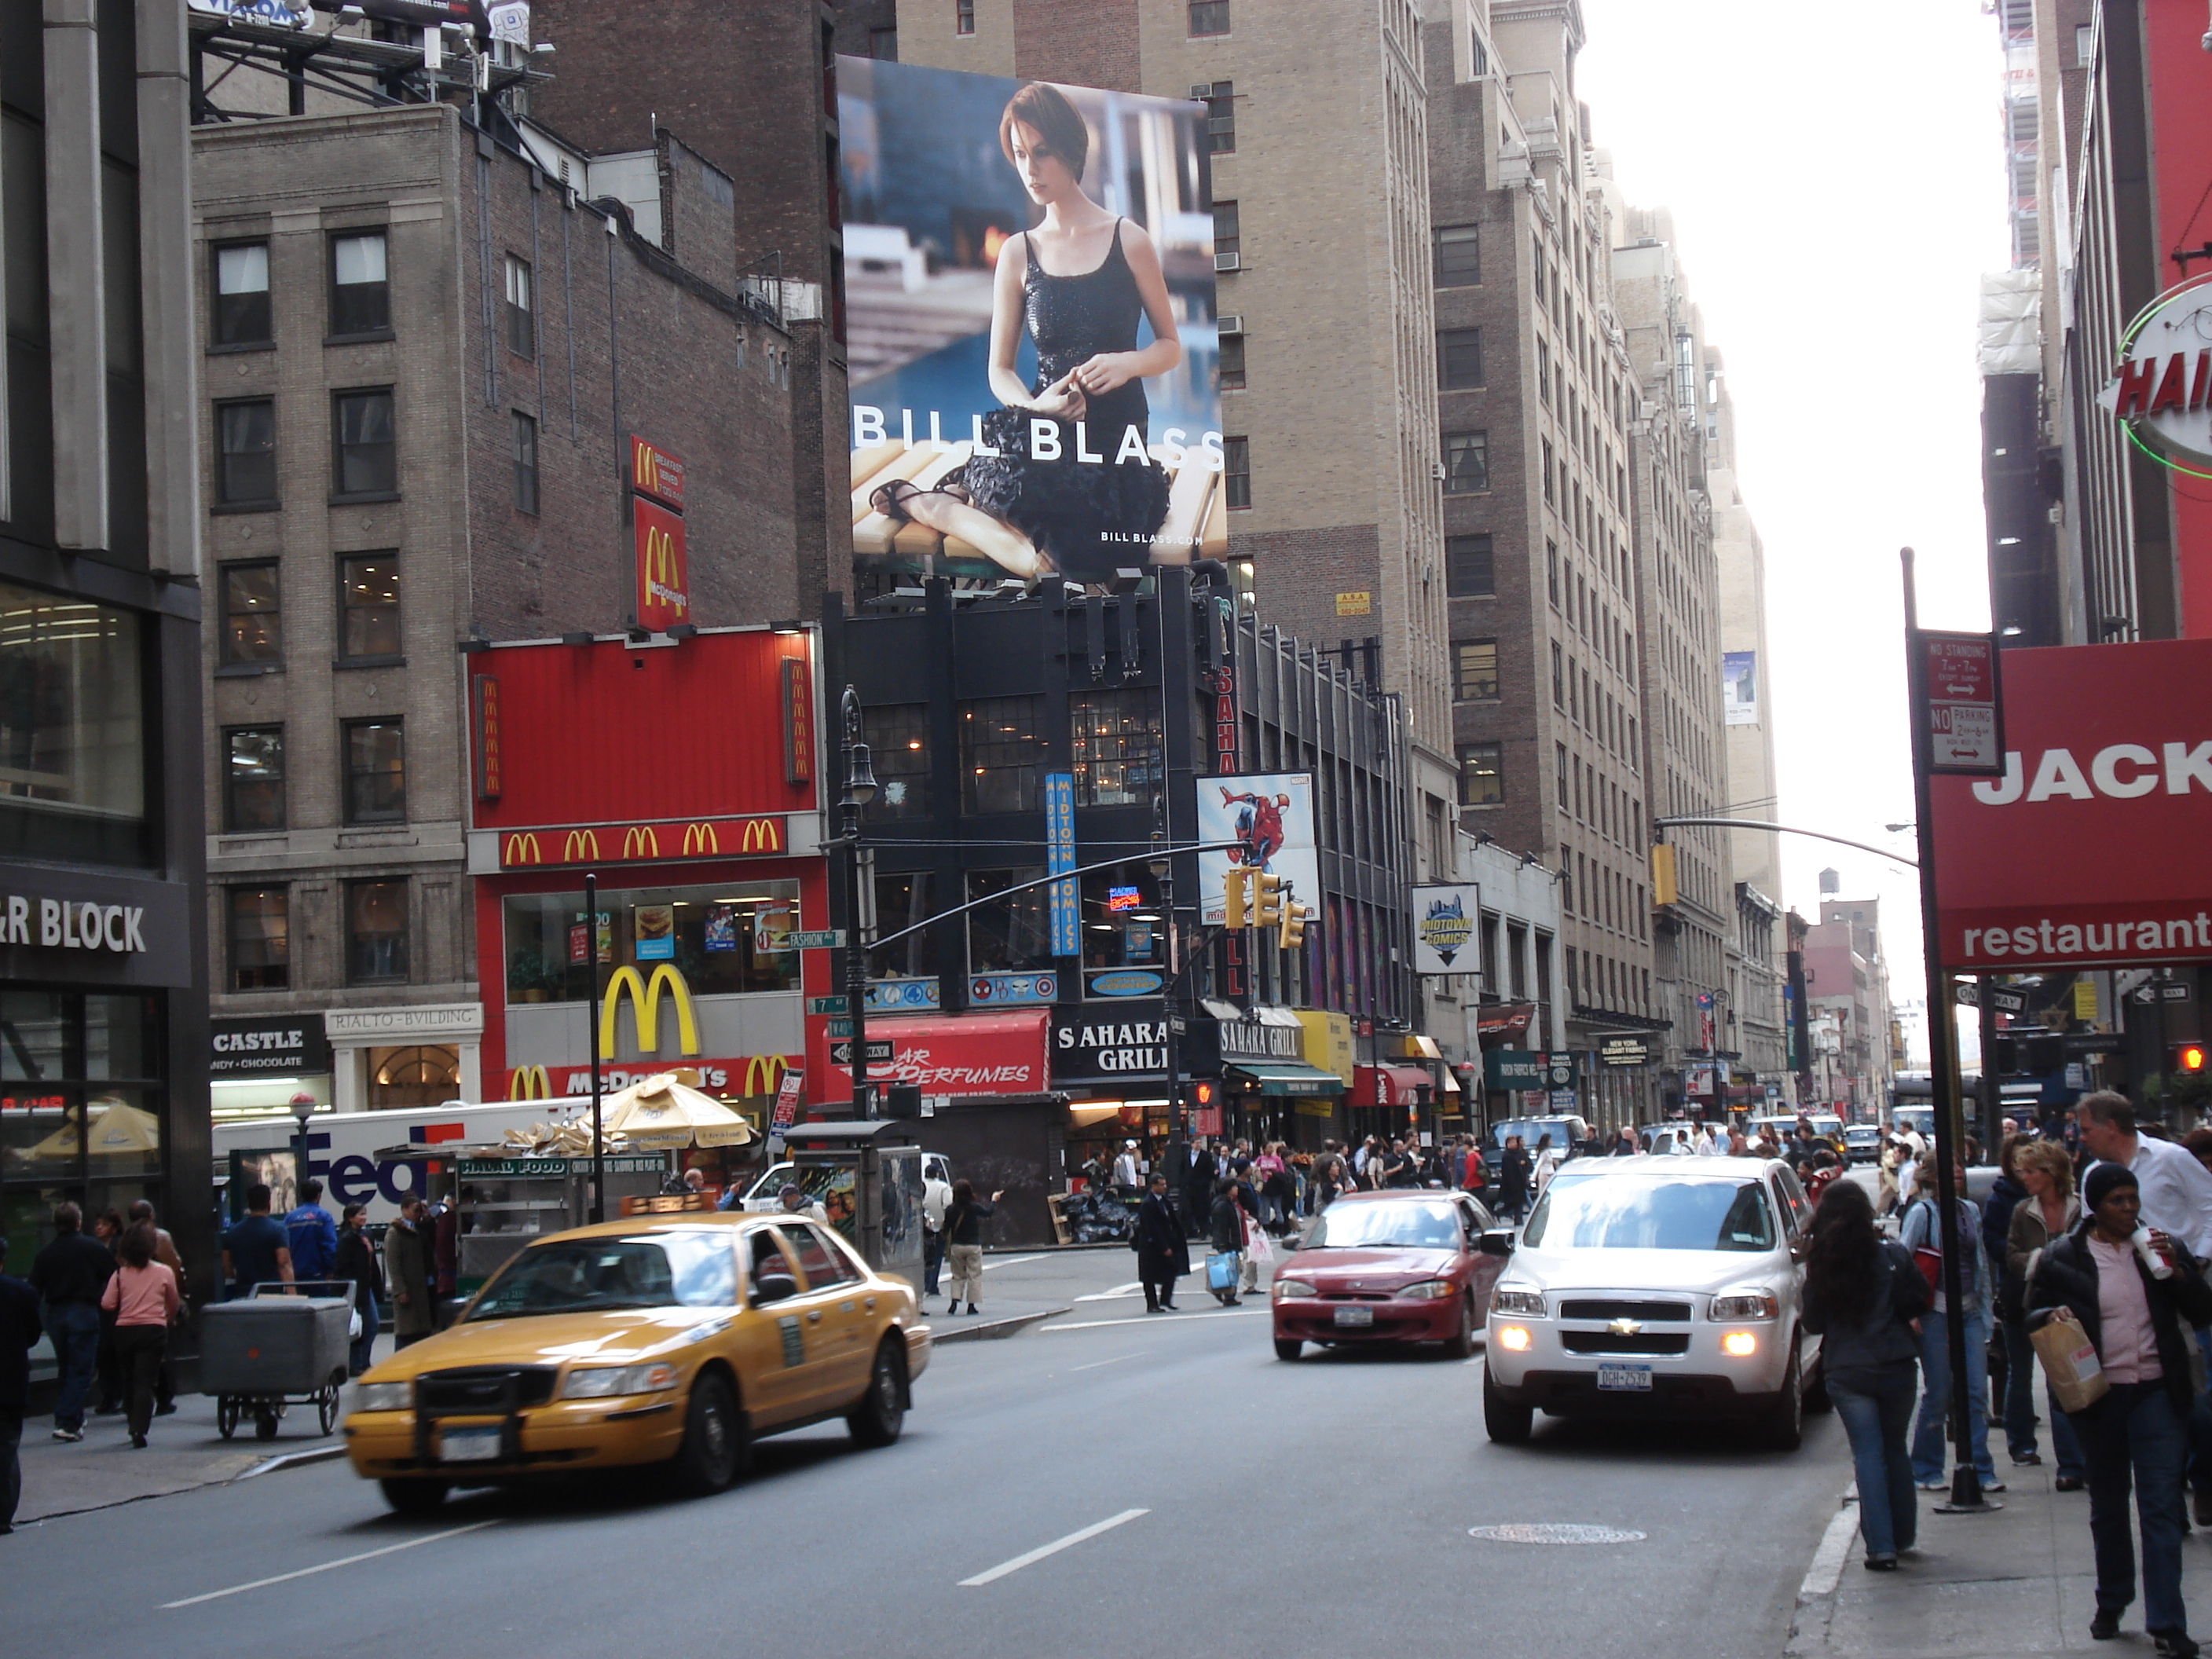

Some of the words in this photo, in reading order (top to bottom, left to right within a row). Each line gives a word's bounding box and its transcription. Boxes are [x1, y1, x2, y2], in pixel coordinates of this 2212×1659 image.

[2115, 347, 2212, 416] HAI
[853, 405, 1001, 457] BILL
[1029, 418, 1223, 471] BLASS
[1101, 531, 1130, 543] BILL
[1133, 533, 1203, 546] BLASS.COM
[650, 580, 687, 608] McDonald's
[1931, 643, 1943, 655] NO
[1946, 644, 1987, 657] STANDING
[1932, 709, 1951, 730] NO
[1954, 709, 1991, 723] PARKING
[1291, 776, 1309, 785] MARVEL
[1058, 780, 1072, 862] MIDTOWN
[40, 898, 147, 953] BLOCK
[1419, 917, 1474, 932] MIDTOWN
[790, 933, 823, 947] FASHION
[1426, 932, 1468, 946] COMICS
[1965, 911, 2211, 958] restaurant
[1097, 981, 1157, 991] COMICS
[1960, 988, 1977, 1001] ON
[819, 1000, 826, 1012] 7
[336, 1013, 394, 1029] RIALTO
[213, 1030, 303, 1053] CASTLE
[1058, 1021, 1167, 1049] SAHARA
[1221, 1022, 1266, 1055] SAHARA
[1270, 1027, 1298, 1057] GRILL
[866, 1046, 885, 1057] WAY
[238, 1057, 302, 1069] CHOCOLATE
[897, 1064, 1031, 1086] PERFUMES
[461, 1160, 514, 1174] HALAL
[518, 1158, 566, 1174] FOOD
